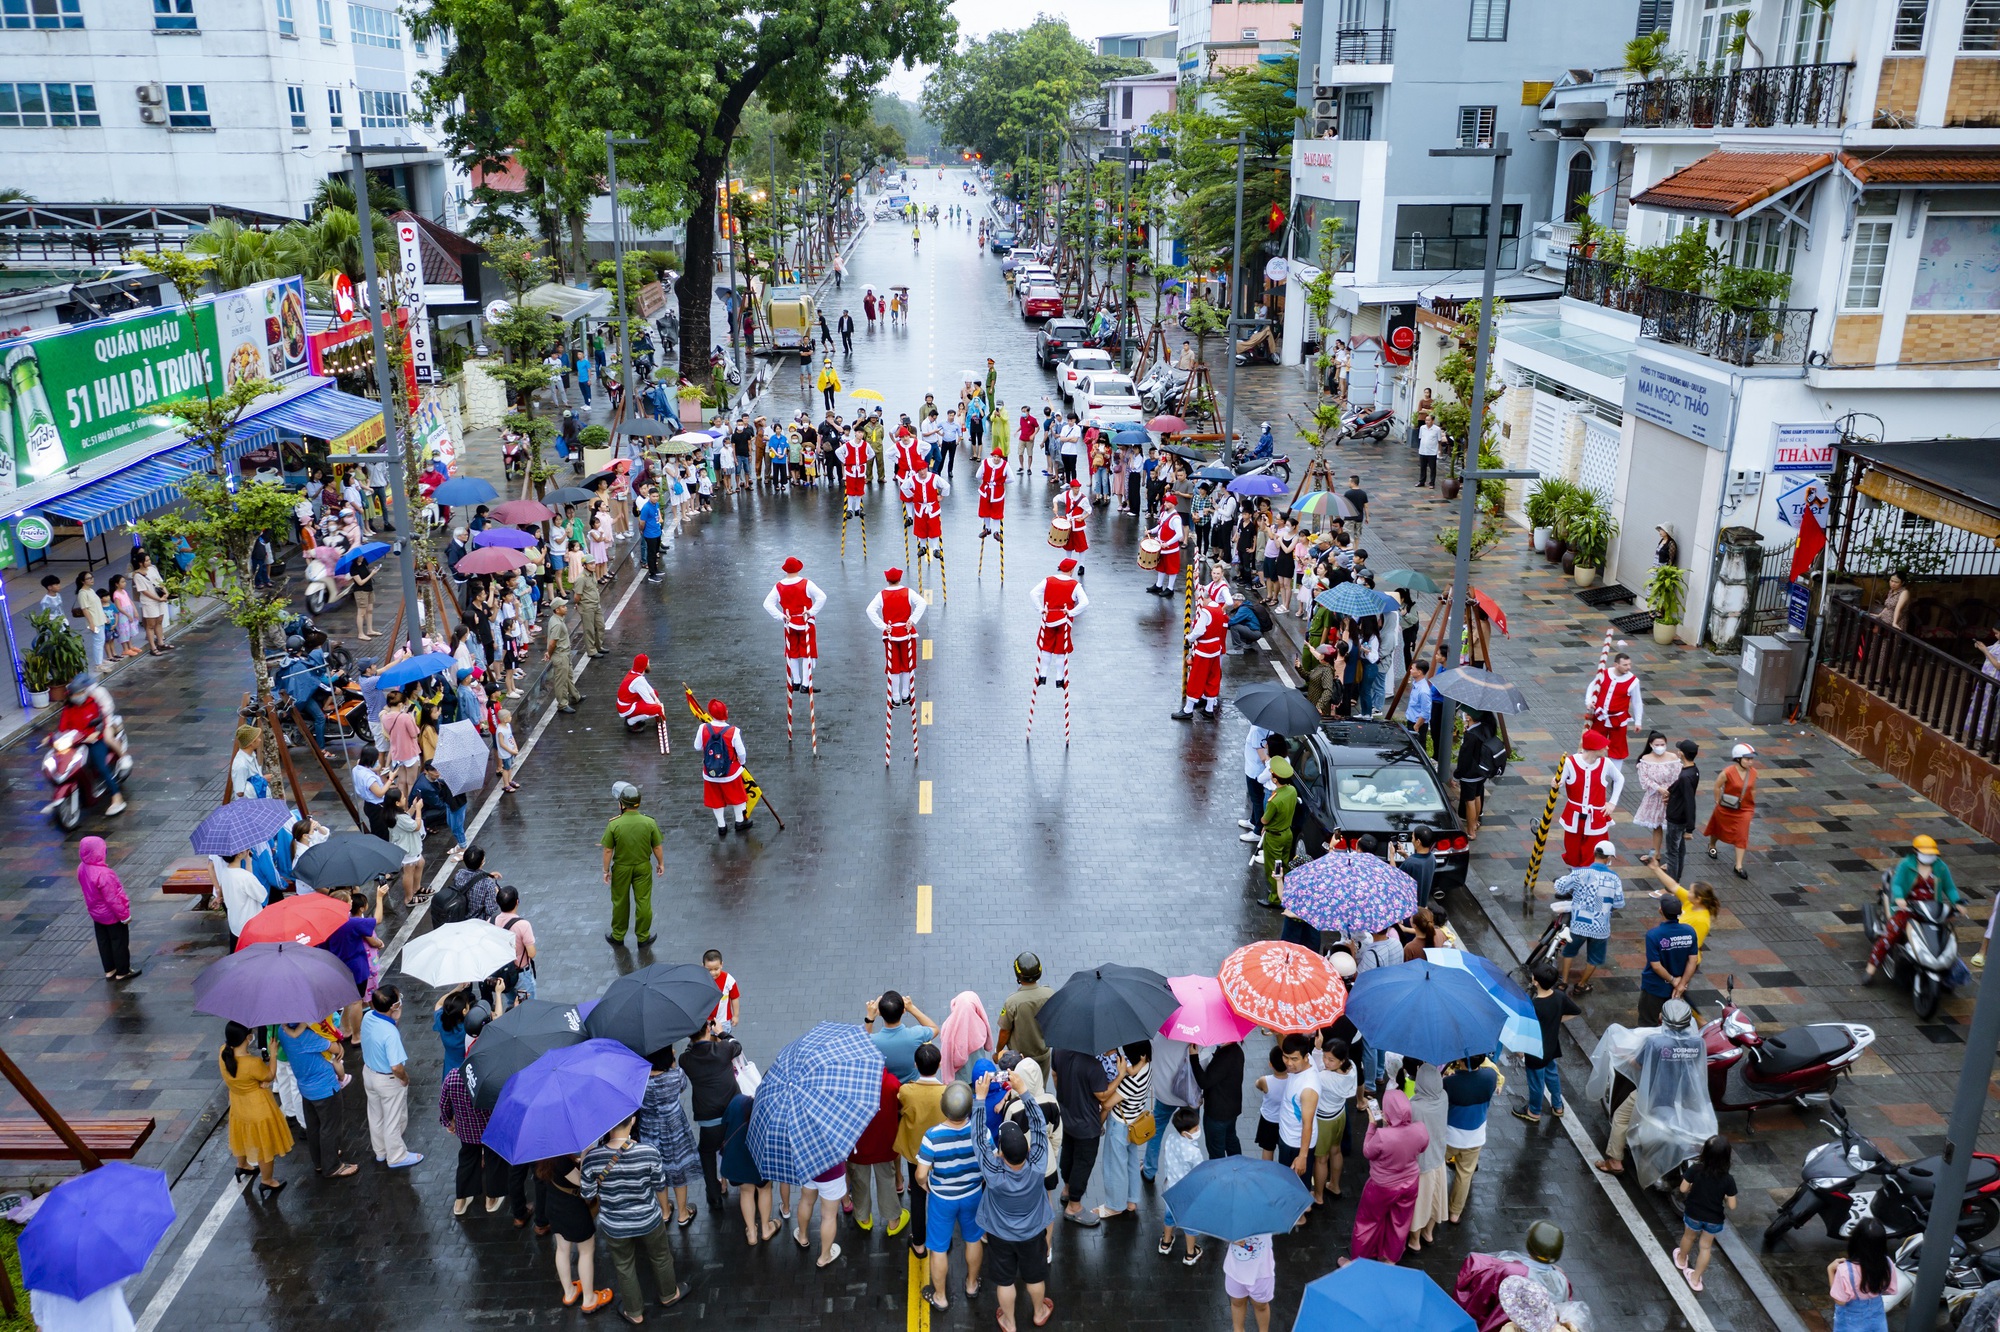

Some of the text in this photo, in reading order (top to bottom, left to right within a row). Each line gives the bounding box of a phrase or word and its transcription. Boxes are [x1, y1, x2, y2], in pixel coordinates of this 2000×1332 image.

[94, 319, 181, 363] QUÁN NHẬU
[418, 367, 429, 376] 51
[66, 348, 214, 429] 51 HAI BÀ TRƯNG
[1638, 379, 1653, 397] MAI
[1654, 385, 1681, 407] NGỌC
[1684, 394, 1709, 416] THẢO
[1777, 444, 1834, 462] THÀNH
[1792, 503, 1825, 518] Tier
